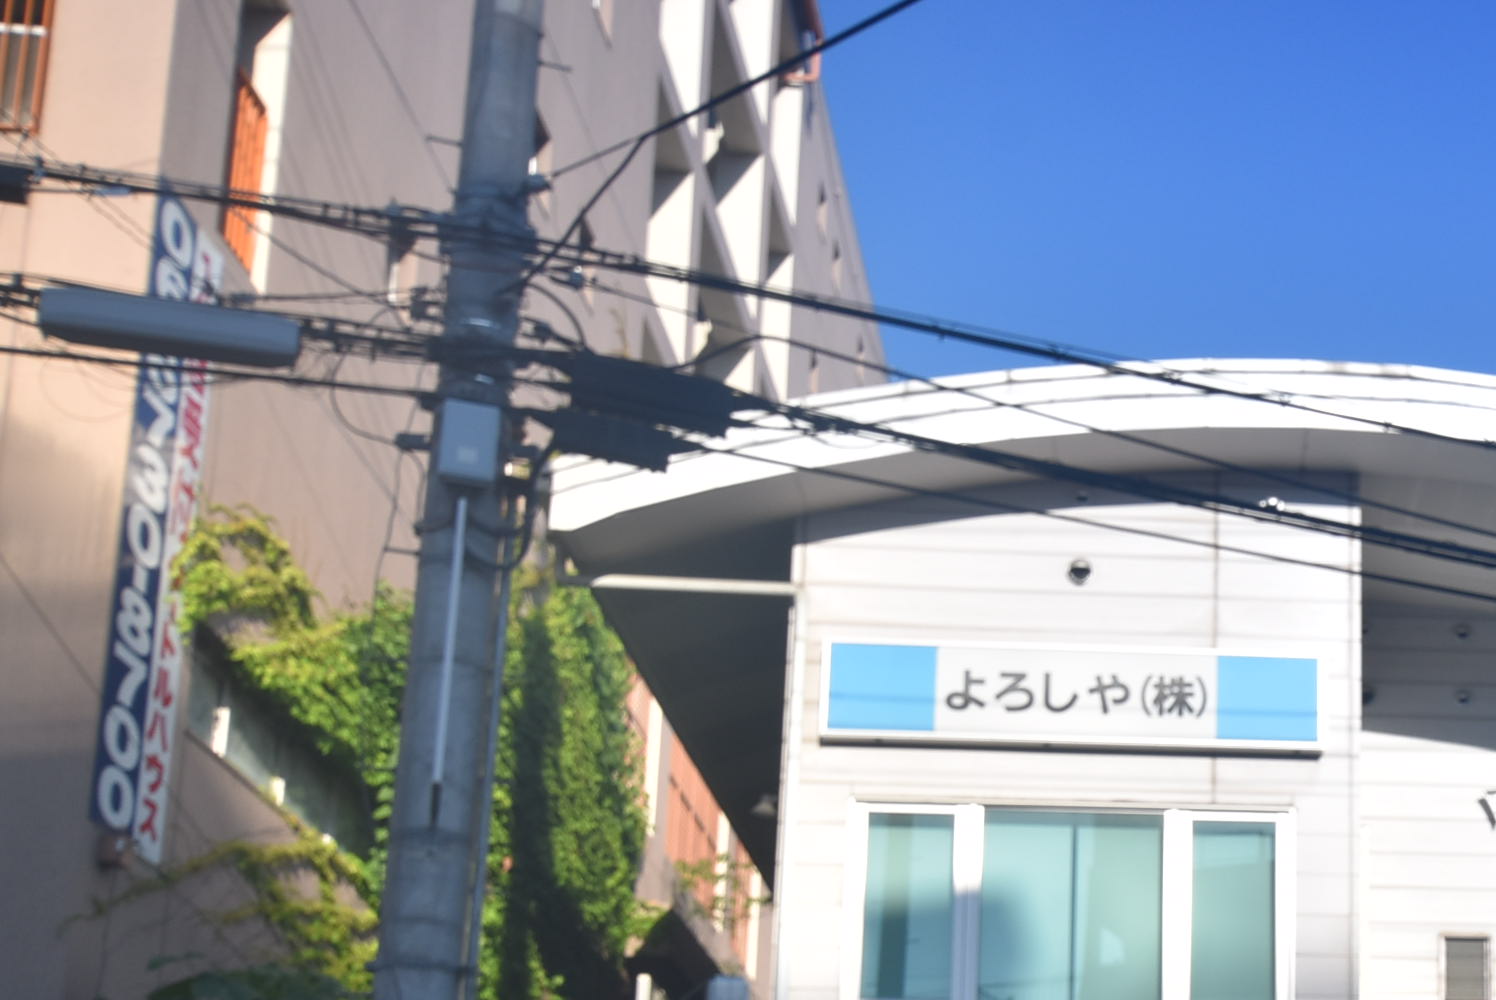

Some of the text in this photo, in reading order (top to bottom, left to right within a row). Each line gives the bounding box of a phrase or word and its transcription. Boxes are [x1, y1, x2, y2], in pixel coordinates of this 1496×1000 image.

[944, 669, 1210, 719] よろしや(株)
